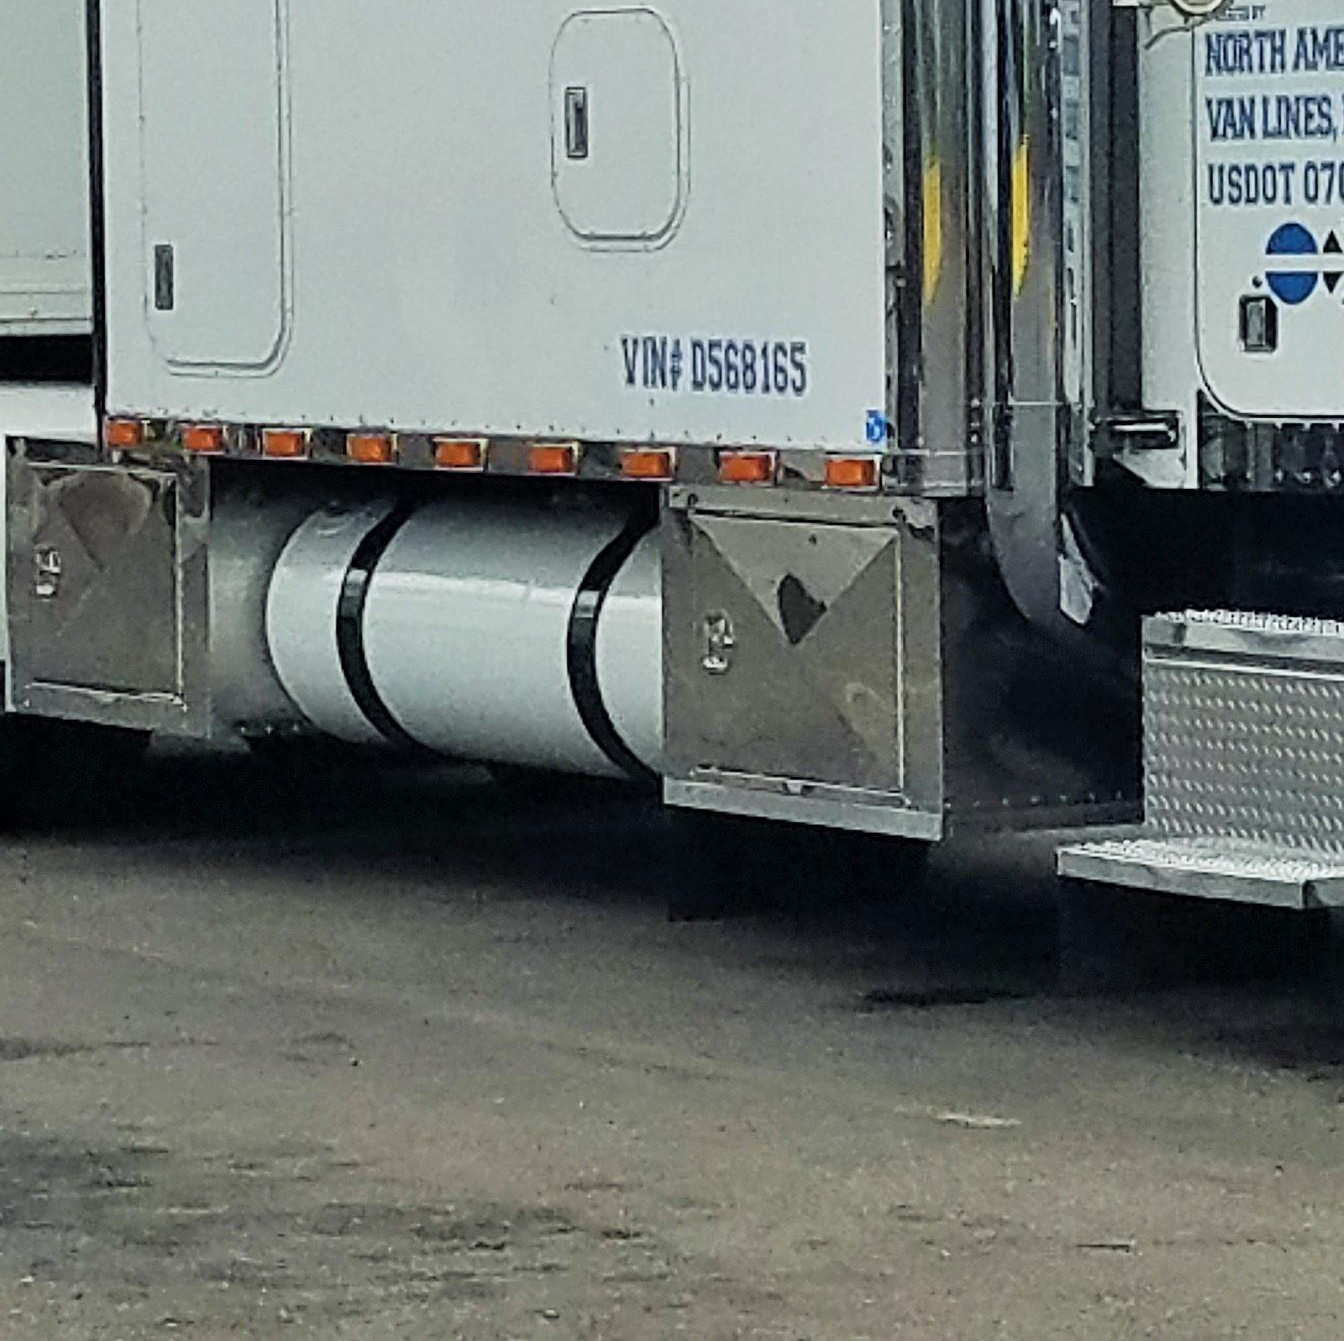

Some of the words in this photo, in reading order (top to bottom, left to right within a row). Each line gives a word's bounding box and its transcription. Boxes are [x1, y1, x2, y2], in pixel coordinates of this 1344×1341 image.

[1205, 29, 1287, 74] NORTH
[1205, 96, 1256, 142] VAN
[1261, 94, 1338, 144] LINES,
[1208, 162, 1296, 206] USDOT
[622, 336, 682, 391] VIN#
[690, 336, 807, 397] D568165
